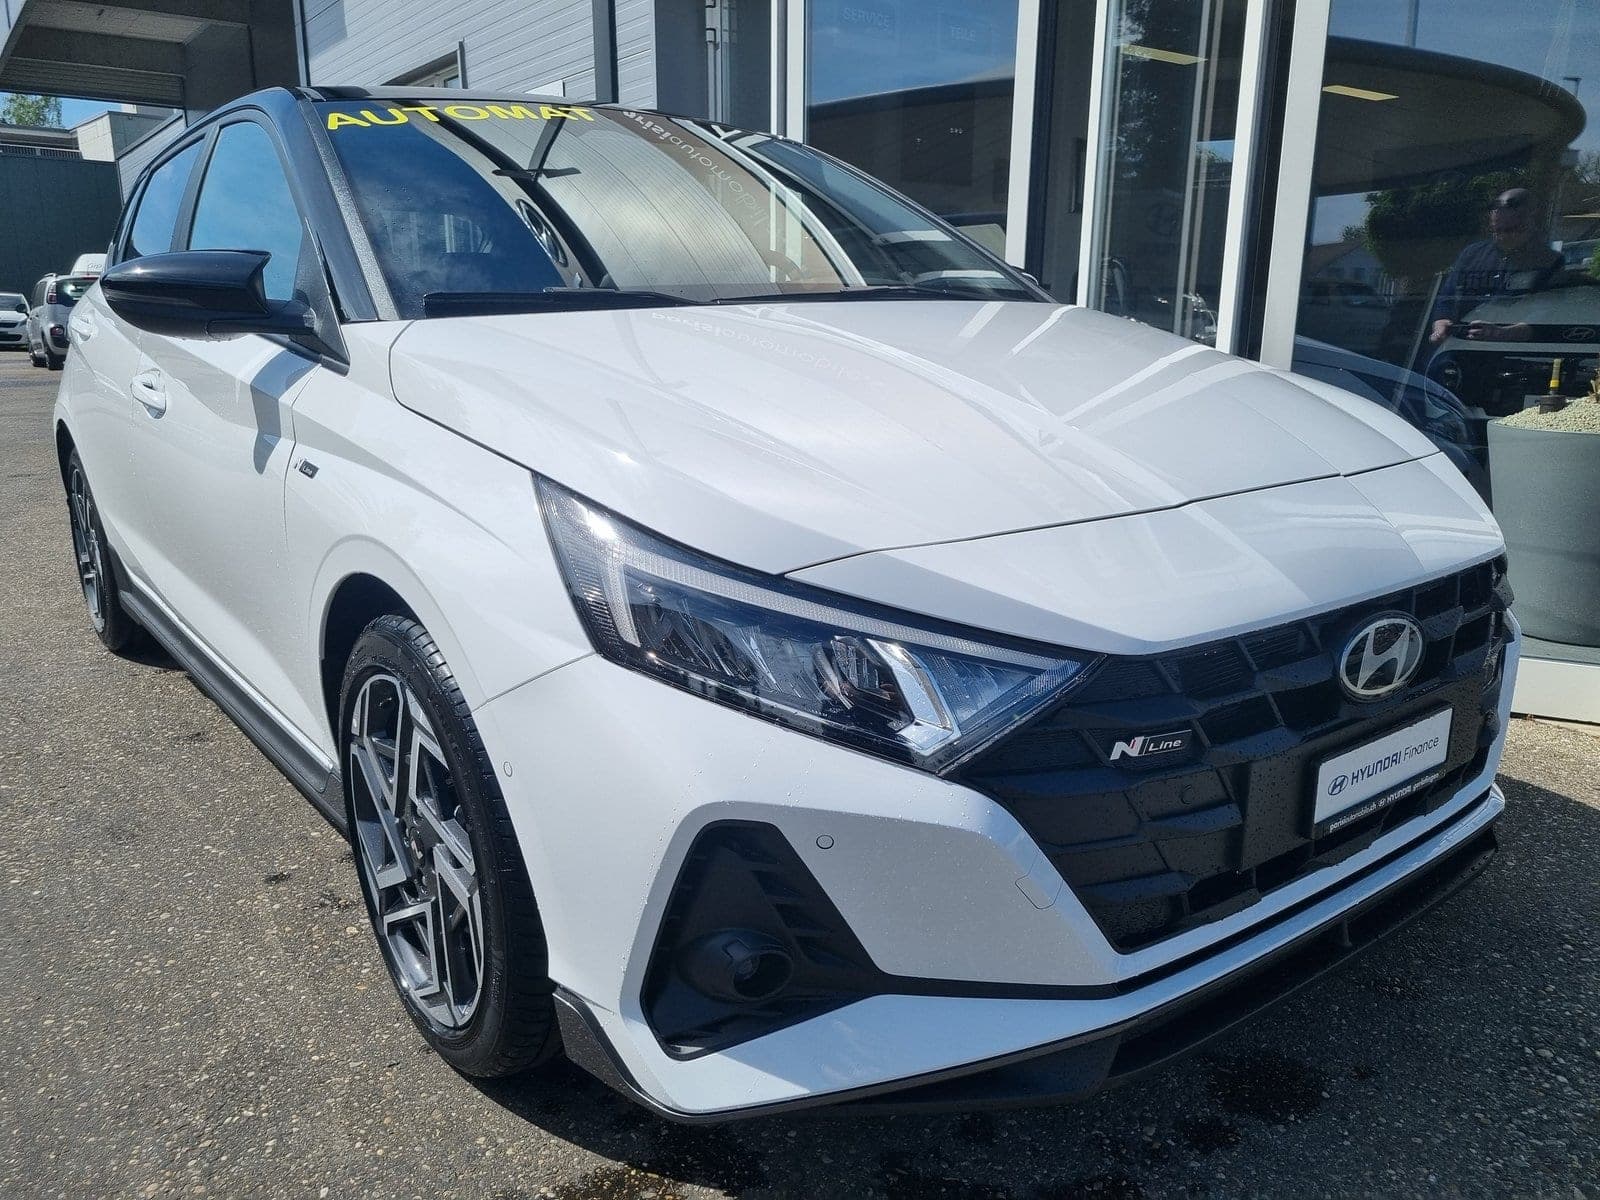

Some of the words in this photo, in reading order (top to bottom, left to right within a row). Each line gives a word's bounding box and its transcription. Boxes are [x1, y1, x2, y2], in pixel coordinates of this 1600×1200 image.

[327, 105, 594, 130] AUTOMAT
[1110, 736, 1144, 760] N
[1351, 751, 1402, 785] HYUNDAI
[1403, 737, 1439, 762] Finance
